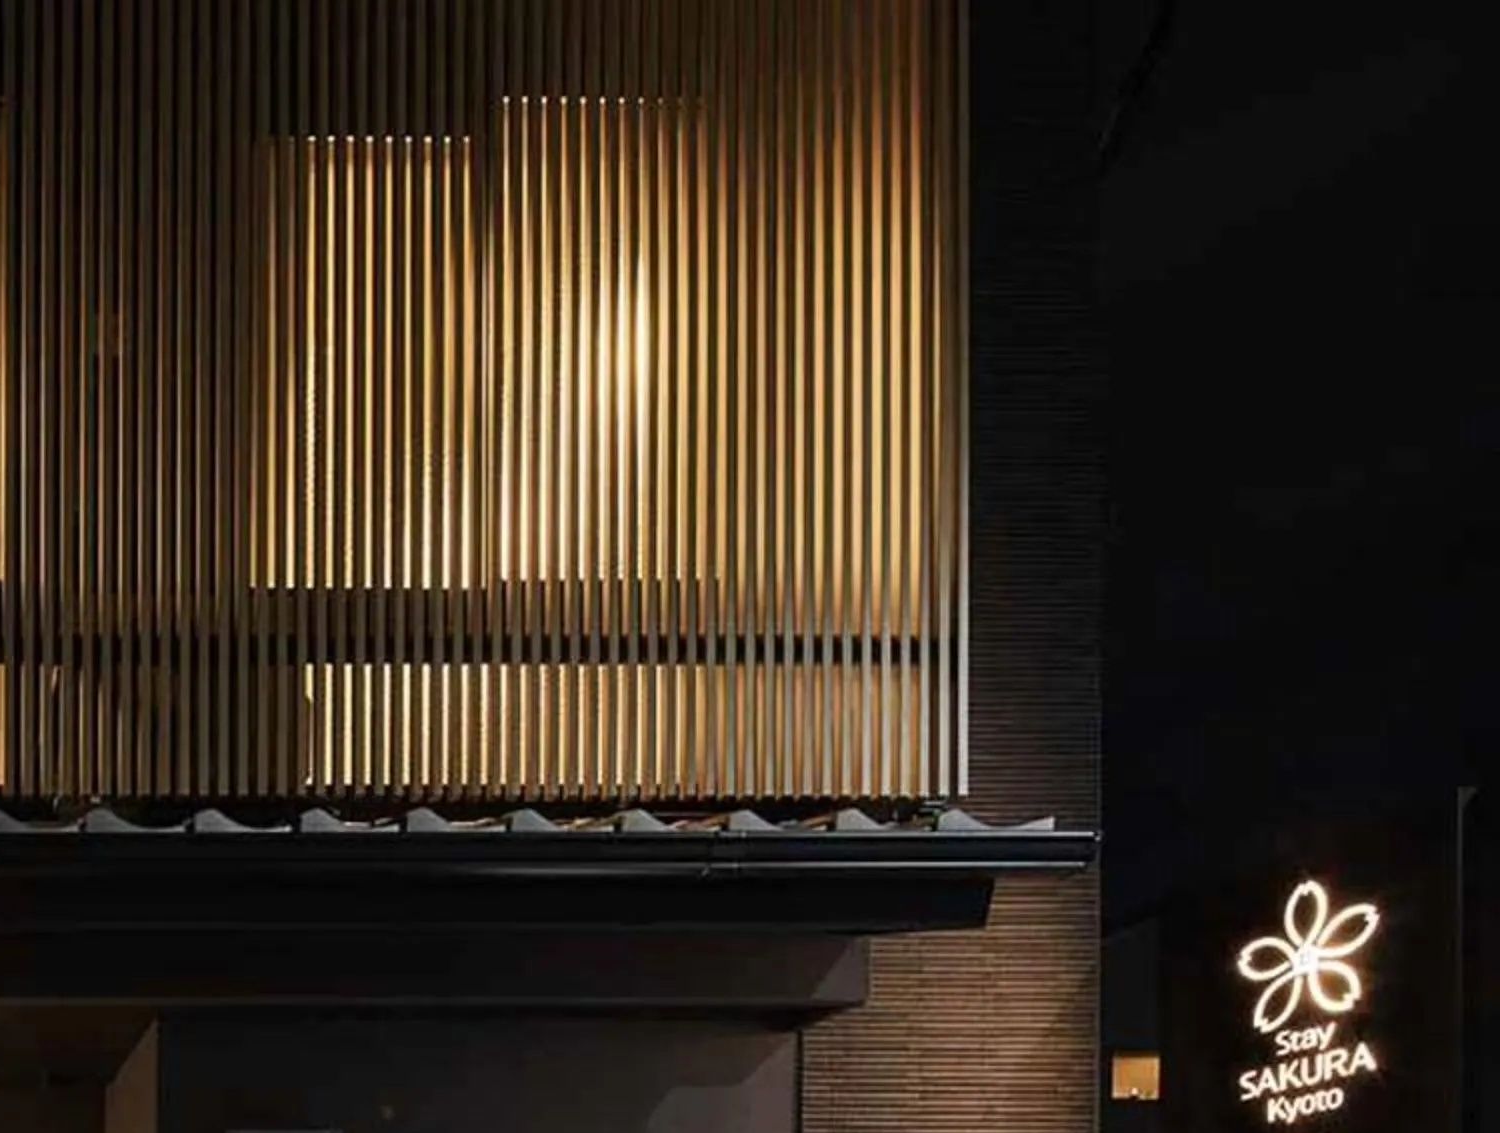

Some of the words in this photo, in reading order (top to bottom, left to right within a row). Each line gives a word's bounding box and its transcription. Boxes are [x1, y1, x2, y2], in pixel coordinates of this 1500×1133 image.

[1274, 1021, 1338, 1056] Stay
[1239, 1041, 1378, 1101] SAKURA
[1267, 1087, 1345, 1124] Kyoto
